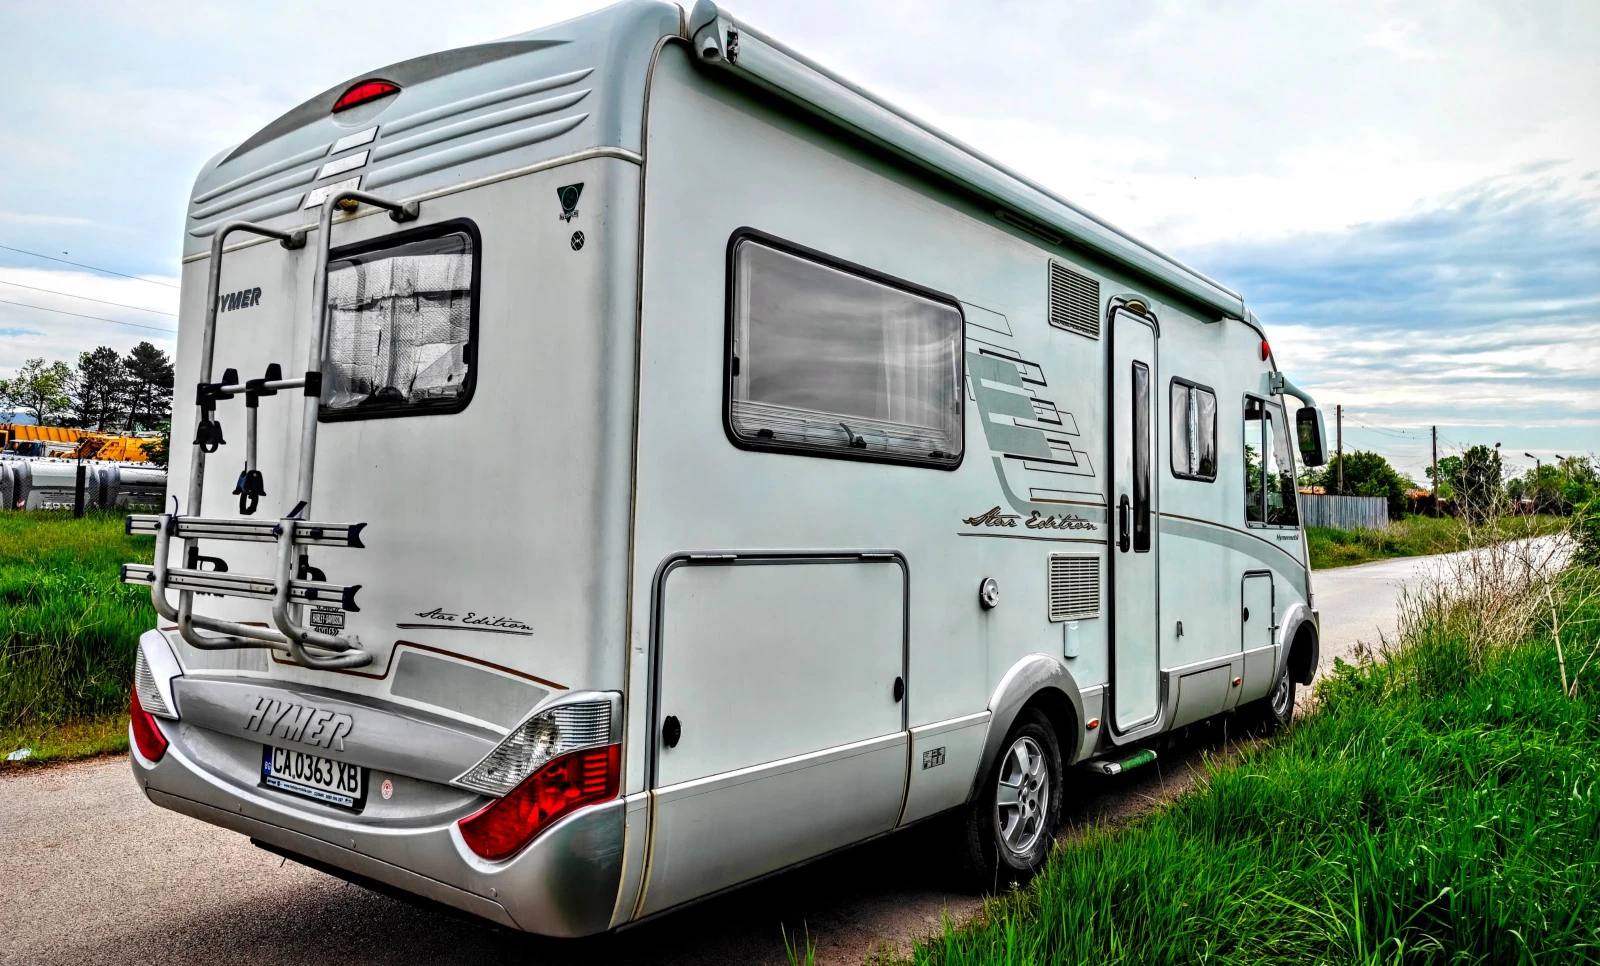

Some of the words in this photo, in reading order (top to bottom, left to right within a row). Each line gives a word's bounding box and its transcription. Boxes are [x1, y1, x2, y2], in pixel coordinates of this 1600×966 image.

[962, 505, 1022, 527] Star
[1025, 510, 1098, 531] Edition
[415, 607, 458, 622] Star
[462, 612, 533, 631] Edition
[243, 696, 353, 752] HYMER
